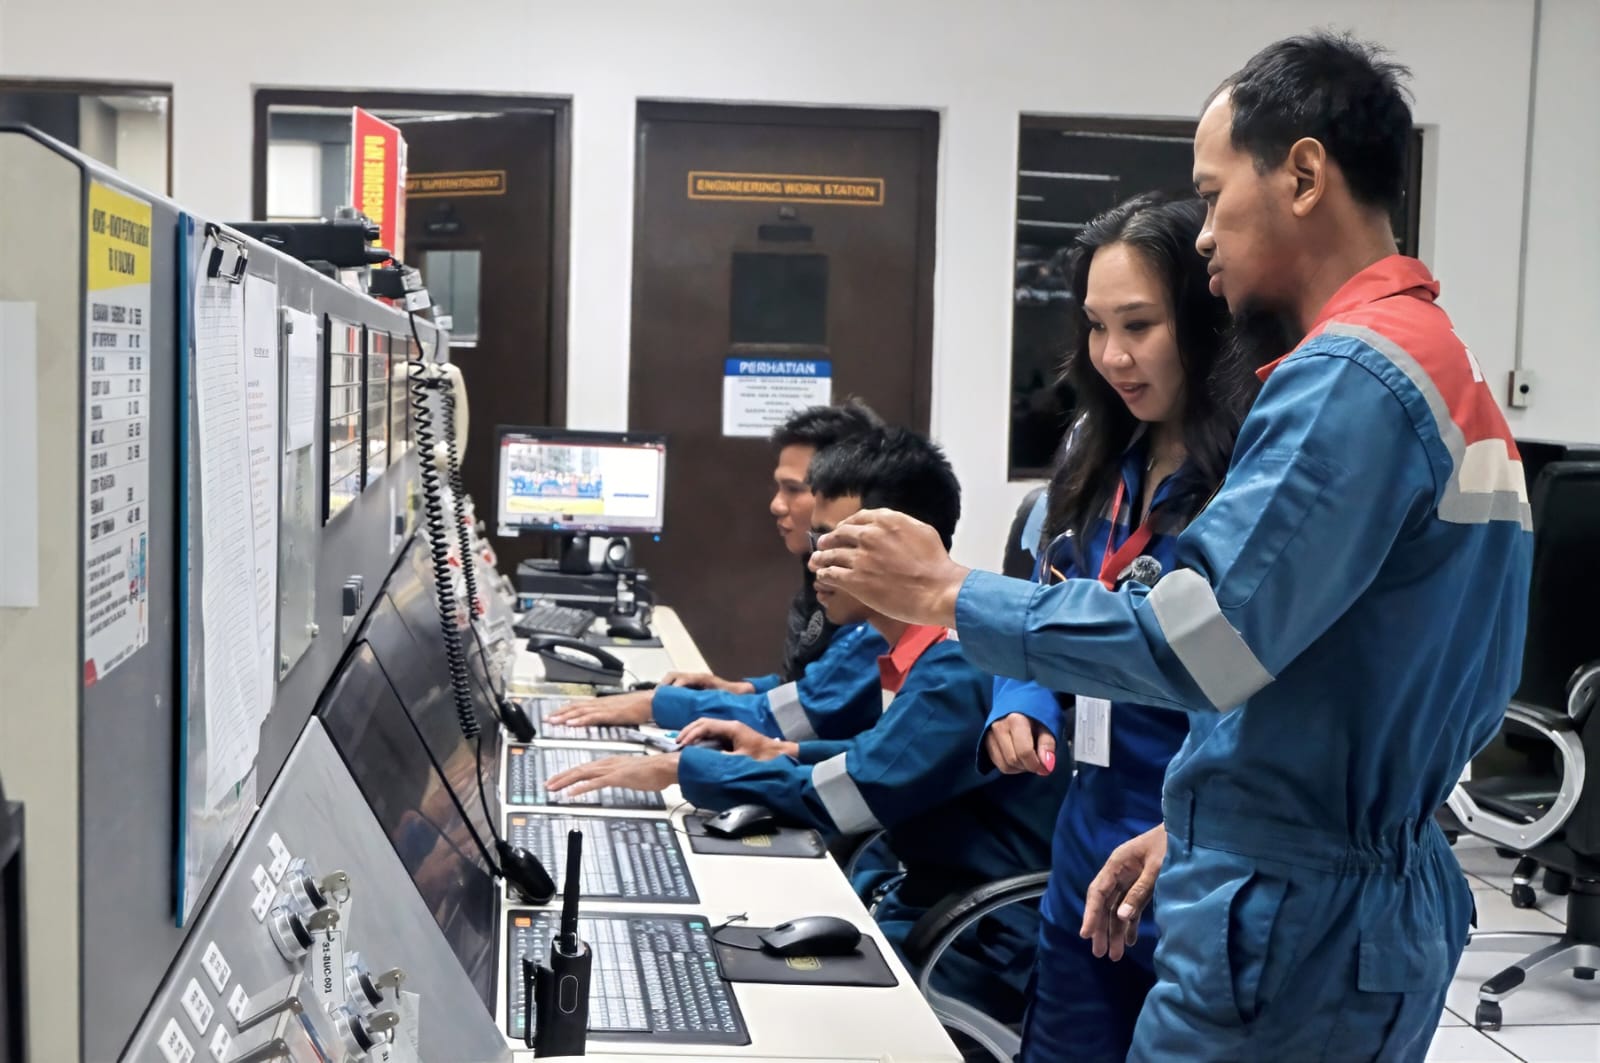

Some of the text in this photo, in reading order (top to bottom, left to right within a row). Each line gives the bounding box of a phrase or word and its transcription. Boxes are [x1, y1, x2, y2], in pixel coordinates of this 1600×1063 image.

[697, 178, 875, 197] ENGINEERING WORK STATION
[739, 361, 816, 374] PERHATIAN
